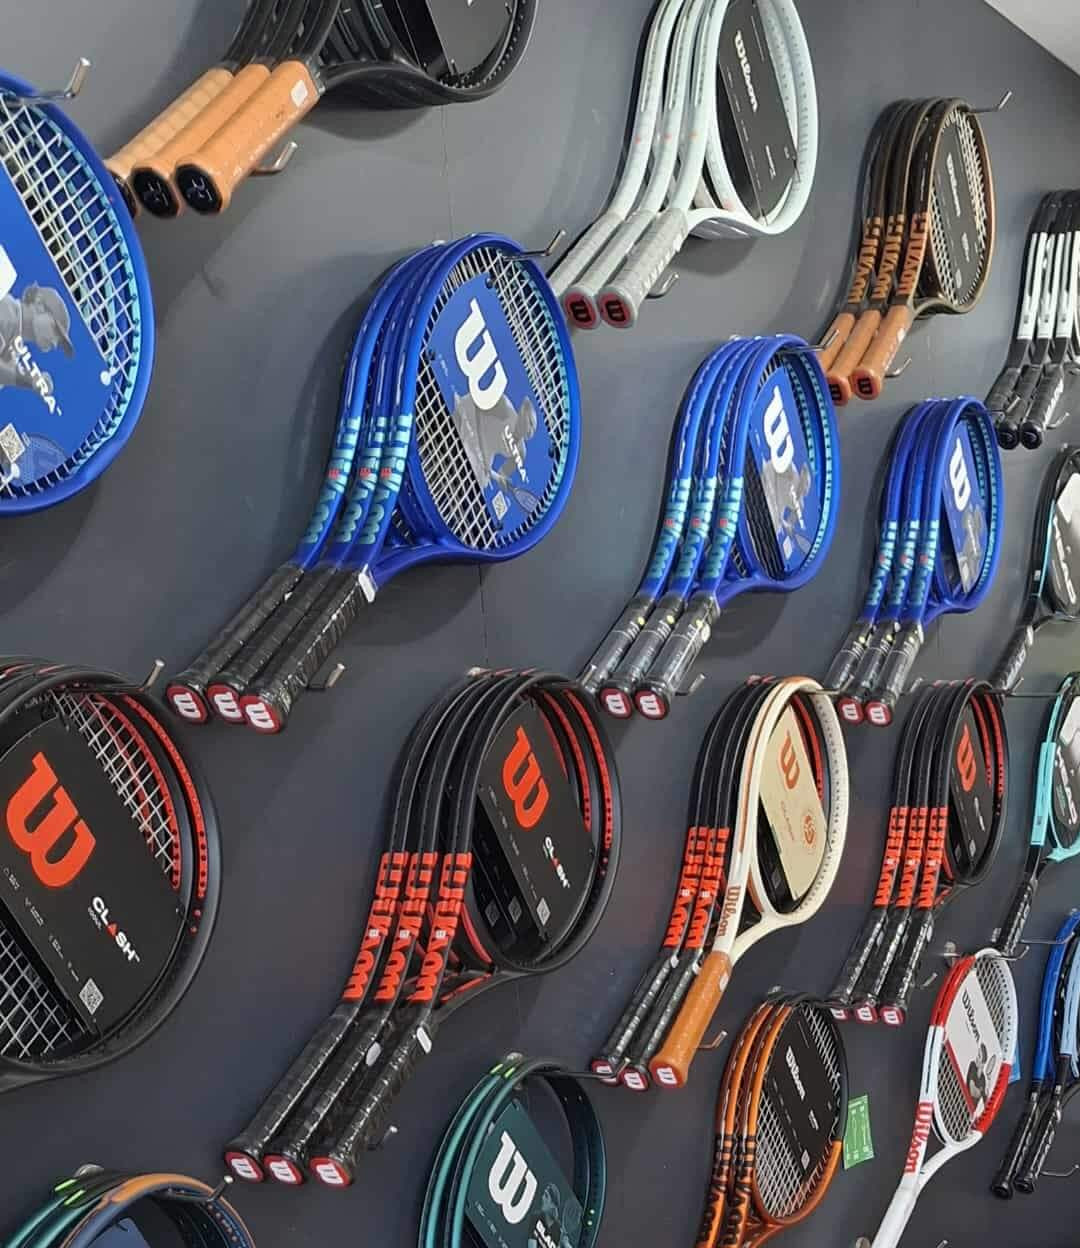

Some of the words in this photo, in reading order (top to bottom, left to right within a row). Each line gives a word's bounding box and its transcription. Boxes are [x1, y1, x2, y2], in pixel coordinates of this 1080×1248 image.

[734, 30, 758, 113] Wilson
[14, 335, 55, 414] ULTRA
[503, 424, 527, 481] ULTRA
[503, 725, 549, 828] W
[6, 751, 96, 888] W
[716, 885, 741, 936] Wilson
[488, 1130, 538, 1224] W
